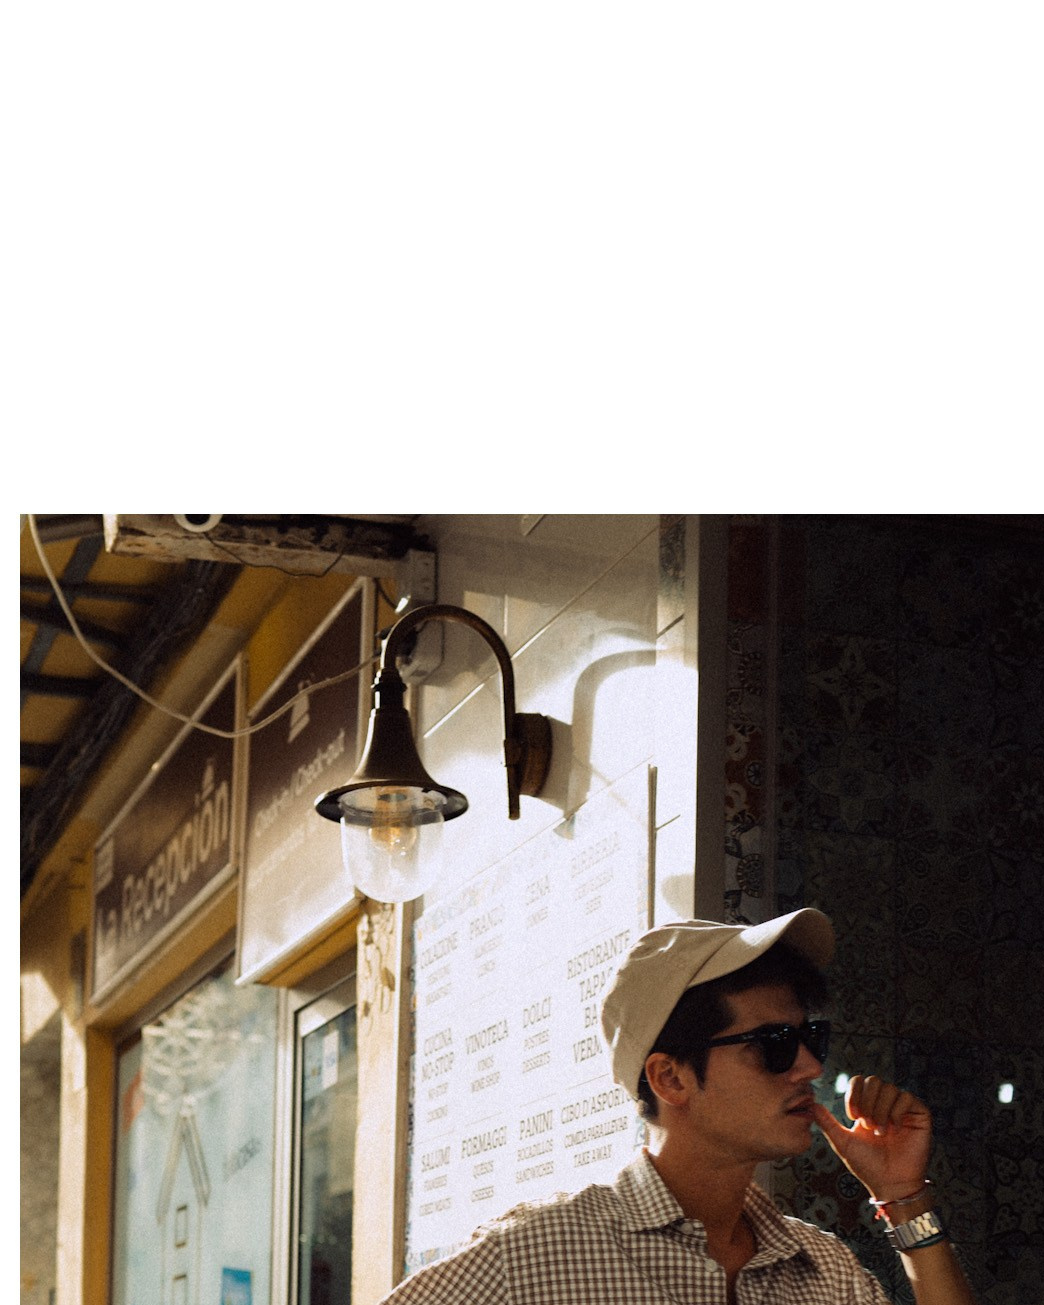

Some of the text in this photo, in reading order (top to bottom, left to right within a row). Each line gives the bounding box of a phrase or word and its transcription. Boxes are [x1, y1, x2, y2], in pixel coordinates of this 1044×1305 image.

[122, 781, 228, 936] Recepción
[525, 874, 551, 906] CENA
[567, 929, 631, 980] RISTORANTE
[522, 996, 552, 1029] DOLCI
[584, 1003, 599, 1029] BA
[423, 1027, 453, 1057] CUCINA
[465, 1019, 510, 1055] VINOTECA
[421, 1052, 455, 1083] NO-STOP
[519, 1109, 554, 1140] PANINI
[561, 1101, 581, 1125] CIBO
[461, 1125, 508, 1159] FORMAGGI
[517, 1139, 554, 1162] BOCADILLOS
[574, 1144, 613, 1168] TAKE AWAY
[421, 1146, 451, 1173] SALUMI
[515, 1161, 555, 1184] SANDWICHES
